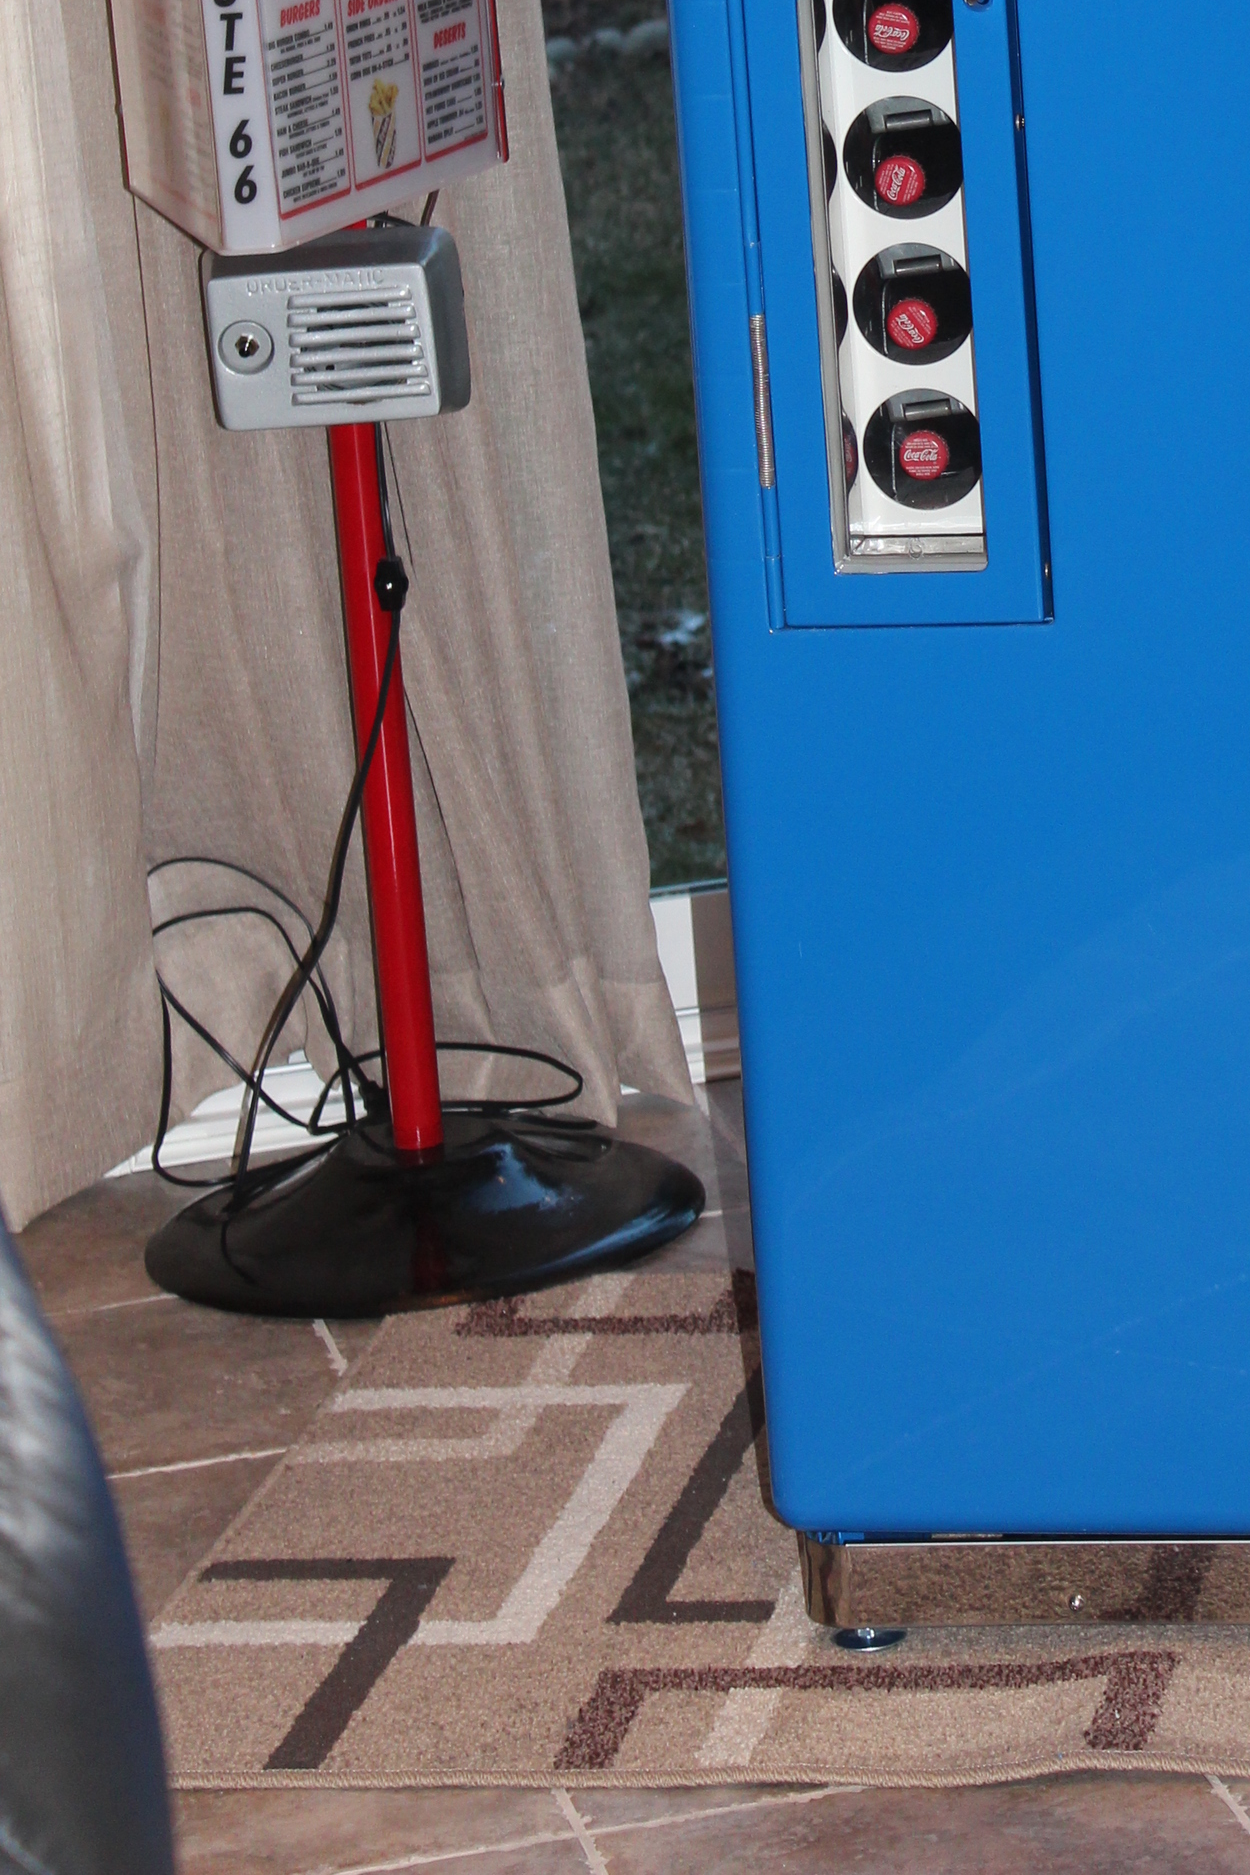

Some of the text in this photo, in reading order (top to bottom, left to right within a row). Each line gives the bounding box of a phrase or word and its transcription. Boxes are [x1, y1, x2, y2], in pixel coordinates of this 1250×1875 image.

[433, 21, 466, 50] DESERTS
[228, 119, 258, 205] 66
[903, 448, 939, 462] Coca-Cola
